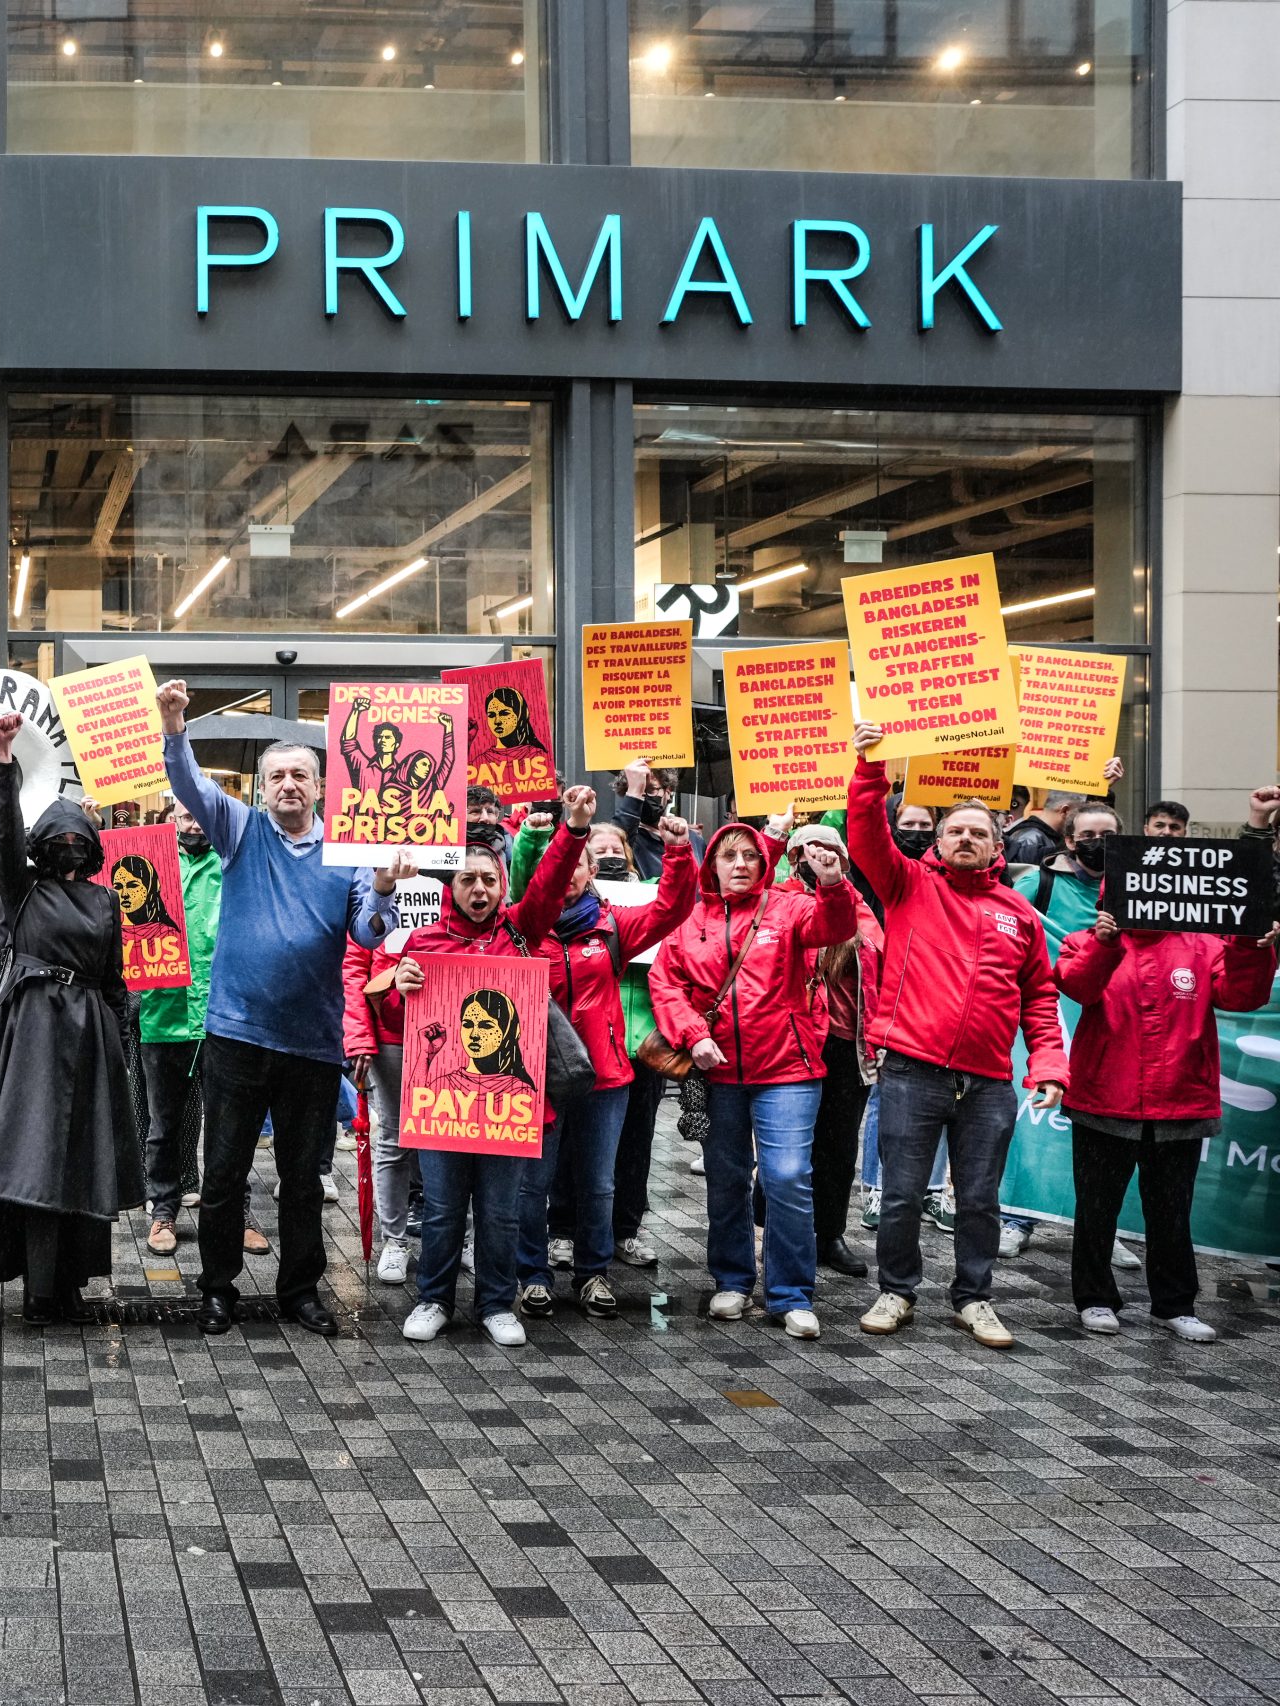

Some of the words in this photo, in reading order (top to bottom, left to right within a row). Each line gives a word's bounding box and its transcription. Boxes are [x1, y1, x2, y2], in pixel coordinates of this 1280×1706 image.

[196, 205, 1002, 332] PRIMARK
[859, 578, 954, 605] ARBEIDERS
[960, 574, 980, 588] IN
[864, 593, 979, 624] BANGLADESH
[592, 632, 606, 640] AU
[611, 628, 682, 640] BANGLADESH,
[882, 615, 967, 640] RISKEREN
[586, 646, 606, 654] DES
[610, 641, 687, 653] TRAVAILLEURS
[869, 633, 986, 661] GEVANGENIS-
[588, 660, 599, 668] ET
[604, 655, 686, 667] TRAVAILLEUSES
[736, 659, 815, 677] ARBEIDERS
[820, 657, 836, 668] IN
[885, 653, 974, 678] STRAFFEN
[63, 672, 125, 696] ARBEIDERS
[128, 669, 142, 679] IN
[603, 671, 653, 681] RISQUENT
[658, 670, 670, 678] LA
[740, 674, 834, 693] BANGLADESH
[866, 681, 914, 699] VOOR
[920, 668, 1000, 691] PROTEST
[68, 681, 143, 708] BANGLADESH
[334, 687, 371, 703] DES
[375, 688, 463, 705] SALAIRES
[601, 686, 640, 696] PRISON
[644, 684, 672, 693] POUR
[82, 696, 139, 718] RISKEREN
[593, 700, 625, 710] AVOIR
[629, 696, 681, 708] PROTESTÉ
[753, 693, 823, 709] RISKEREN
[908, 693, 963, 712] TEGEN
[77, 708, 153, 733] GEVANGENIS-
[368, 706, 441, 723] DIGNES
[605, 714, 645, 723] CONTRE
[650, 712, 669, 720] DES
[742, 709, 838, 726] GEVANGENIS-
[881, 708, 997, 735] HONGERLOON
[90, 722, 149, 744] STRAFFEN
[605, 727, 654, 737] SALAIRES
[658, 726, 671, 734] DE
[755, 726, 828, 742] STRAFFEN
[935, 727, 1005, 743] #WagesNotJail
[80, 746, 113, 761] VOOR
[620, 740, 657, 750] MISÈRE
[739, 748, 778, 760] VOOR
[784, 742, 847, 757] PROTEST
[110, 752, 147, 769] TEGEN
[773, 761, 817, 775] TEGEN
[468, 762, 507, 785] PAY
[514, 756, 548, 781] US
[517, 778, 554, 793] WAGE
[750, 776, 844, 794] HONGERLOON
[341, 788, 401, 815] PAS
[412, 789, 451, 815] LA
[331, 816, 458, 843] PRISON
[1141, 847, 1233, 869] #STOP
[1125, 873, 1248, 897] BUSINESS
[394, 892, 440, 906] #RANA
[1127, 900, 1247, 925] IMPUNITY
[141, 936, 180, 963] US
[143, 962, 188, 978] WAGE
[411, 1087, 478, 1120] PAY
[485, 1092, 533, 1125] US
[403, 1118, 416, 1133] A
[421, 1118, 480, 1139] LIVING
[484, 1123, 538, 1143] WAGE
